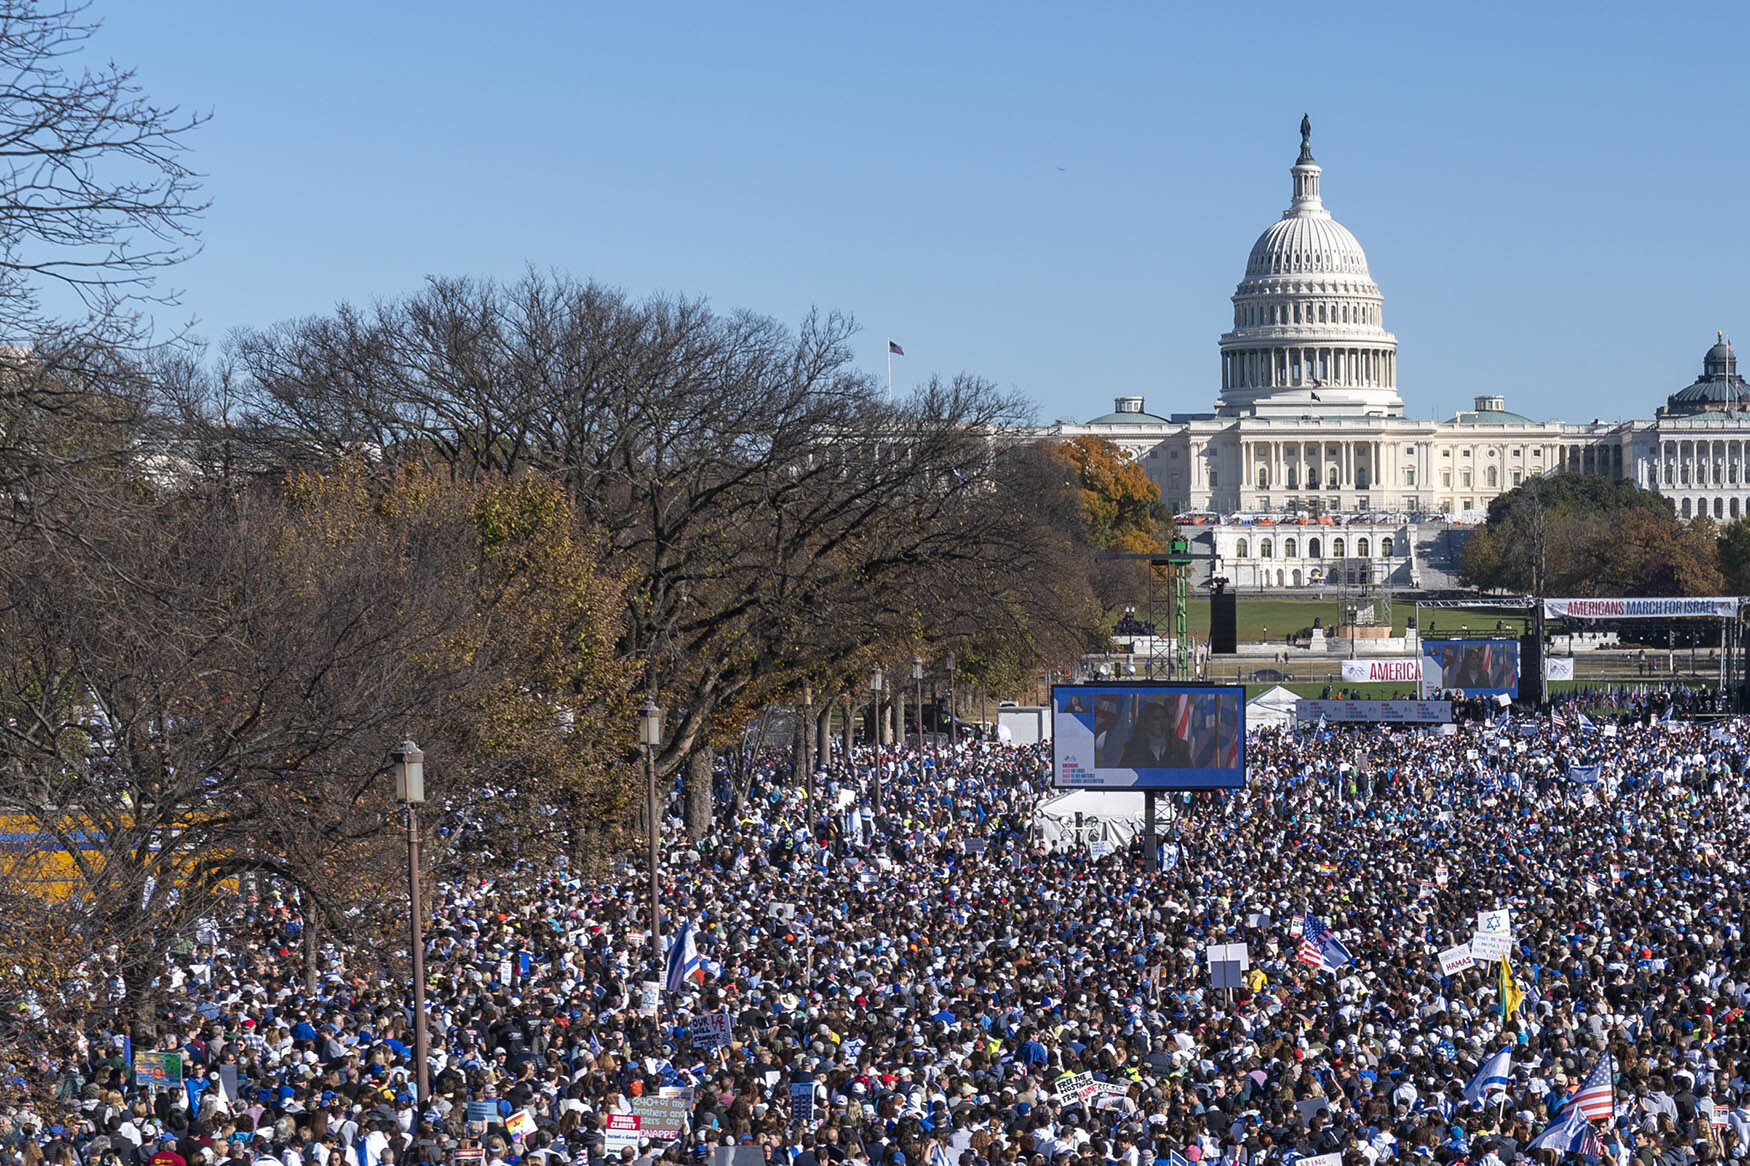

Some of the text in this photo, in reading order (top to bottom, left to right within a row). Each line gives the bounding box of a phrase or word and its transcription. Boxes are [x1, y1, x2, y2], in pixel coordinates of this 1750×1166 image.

[1567, 600, 1717, 617] AMERICANS MARCH FOR ISRAEL
[1370, 662, 1422, 681] AMERICA
[1445, 957, 1472, 971] HAMAS
[692, 1018, 709, 1028] OUR
[1057, 1074, 1087, 1089] FREE THE
[1059, 1078, 1093, 1095] HOSTAGES
[1062, 1091, 1079, 1103] FROM
[633, 1098, 659, 1107] 240+
[672, 1100, 686, 1109] my
[633, 1106, 685, 1117] brothers and
[640, 1116, 680, 1126] sters are
[640, 1128, 684, 1140] DNAPPED
